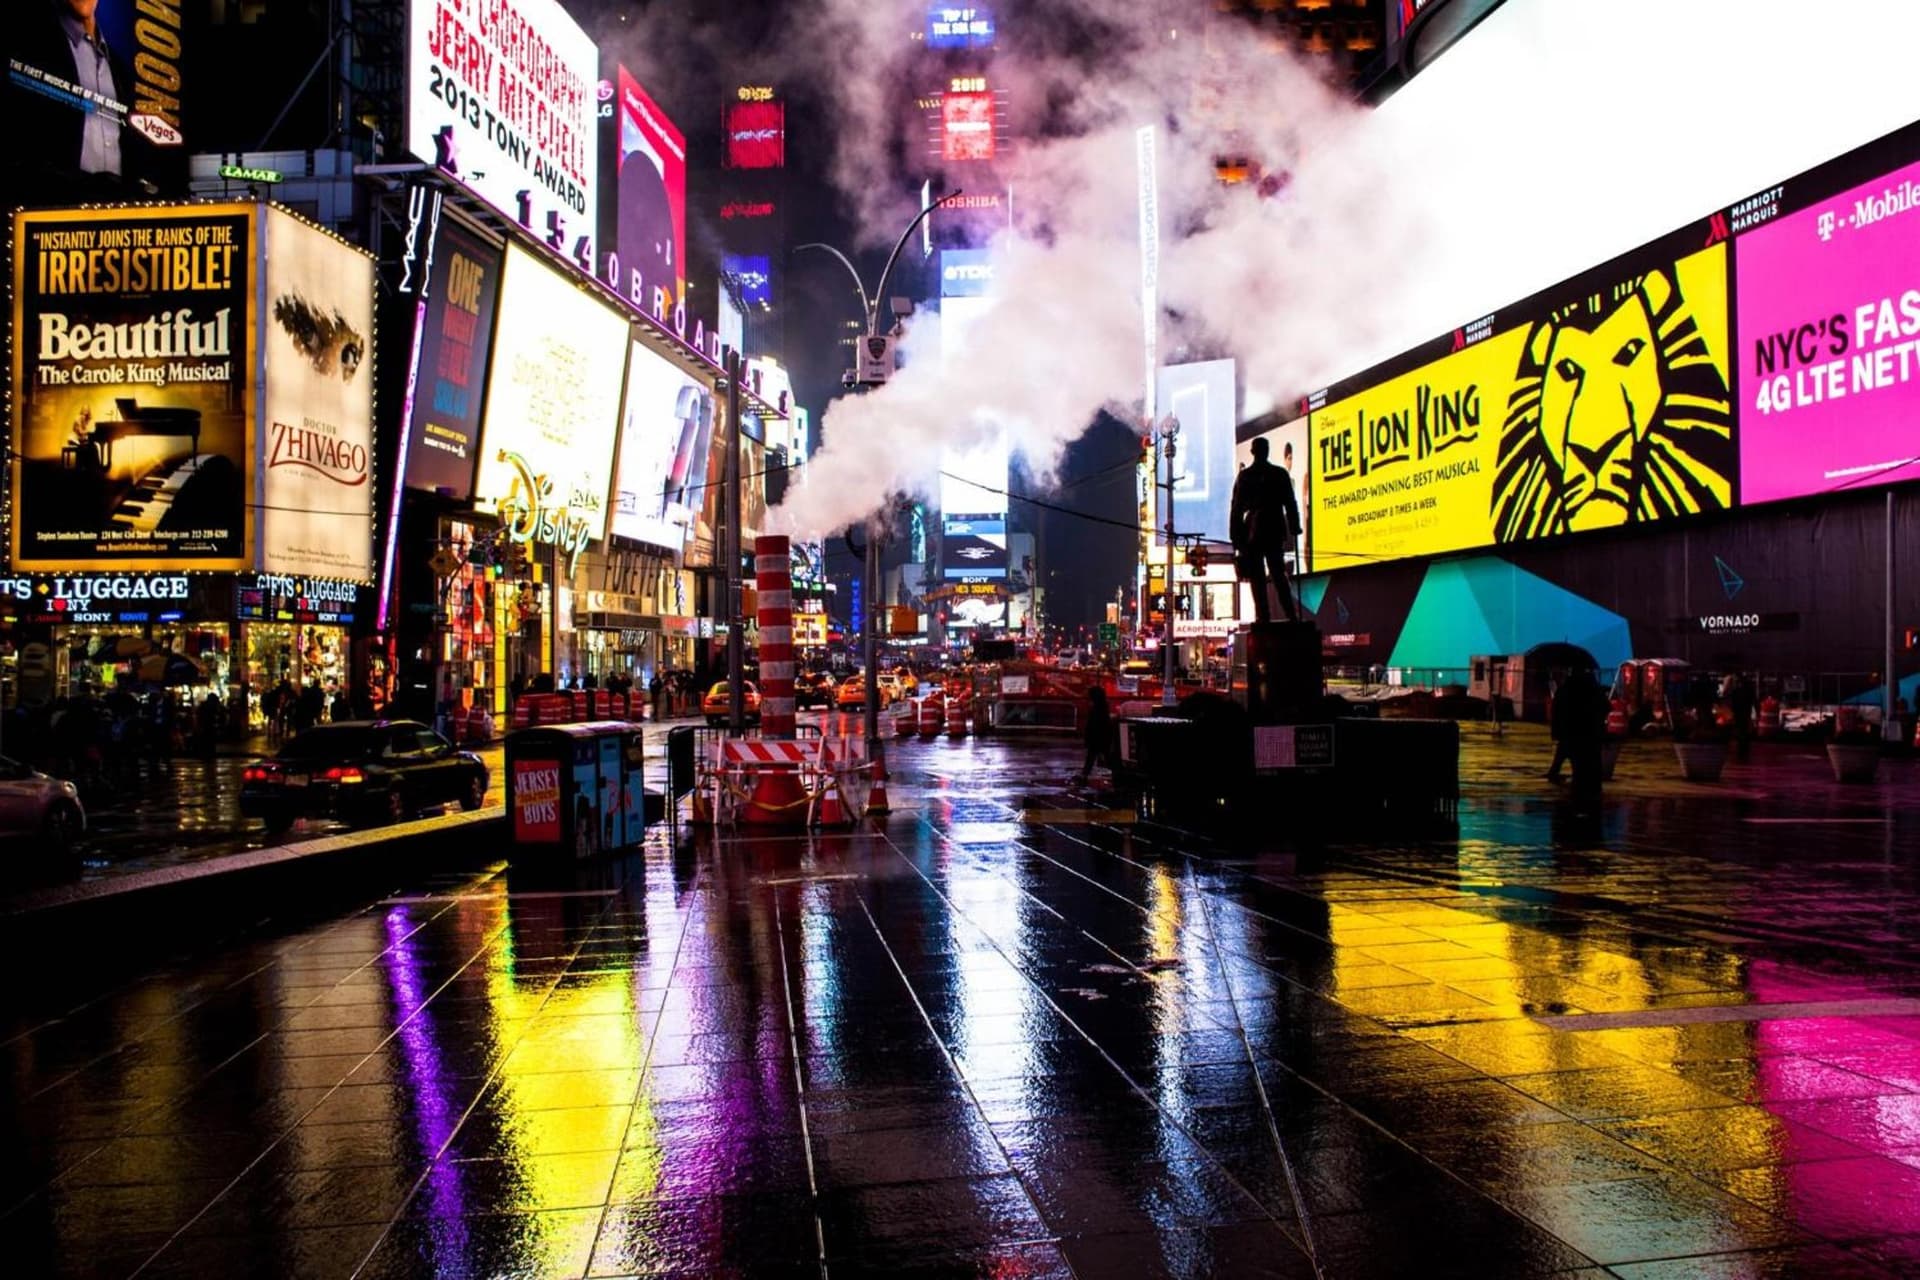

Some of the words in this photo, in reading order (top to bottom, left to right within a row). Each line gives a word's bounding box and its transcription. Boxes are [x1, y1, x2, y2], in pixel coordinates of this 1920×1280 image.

[429, 2, 493, 101] JERRY
[24, 65, 43, 81] FIRST
[43, 72, 71, 94] MUSICAL
[143, 115, 176, 142] Vegas
[429, 64, 481, 131] 2013
[484, 109, 532, 171] TONY
[533, 154, 587, 216] AWARD
[224, 165, 279, 182] LAMAR
[937, 196, 999, 209] TOSHIBA
[1731, 186, 1784, 218] MARRIOTT
[1731, 203, 1778, 233] MARQUIS
[99, 229, 131, 249] JOINS
[132, 228, 153, 247] THE
[155, 227, 193, 247] RANKS
[195, 226, 210, 245] OF
[212, 225, 233, 244] THE
[446, 252, 484, 317] ONE
[38, 307, 231, 361] Beautiful
[1756, 313, 1850, 377] NYC'S
[38, 364, 70, 385] The
[71, 364, 124, 384] Carole
[126, 362, 166, 386] King
[168, 360, 231, 382] Musical
[1756, 374, 1792, 415] 4G
[1796, 359, 1847, 408] LTE
[303, 416, 337, 435] DOCTOR
[1319, 428, 1352, 473] THE
[1358, 409, 1409, 477] LION
[1416, 384, 1480, 460] KING
[269, 421, 367, 475] ZHIVAGO
[1323, 495, 1338, 510] THE
[1338, 475, 1412, 506] AWARD-WINNING
[1412, 469, 1435, 489] BEST
[1434, 457, 1481, 483] MUSICAL
[1347, 514, 1358, 526] ON
[1395, 501, 1412, 515] TIMES
[1418, 496, 1438, 511] WEEK
[54, 577, 189, 599] LUGGAGE
[256, 574, 295, 599] GIFTS
[303, 578, 358, 603] LUGGAGE
[73, 612, 112, 622] SONY
[1699, 613, 1760, 629] VORNADO
[514, 767, 560, 794] JERSEY
[523, 803, 557, 825] BOYS
